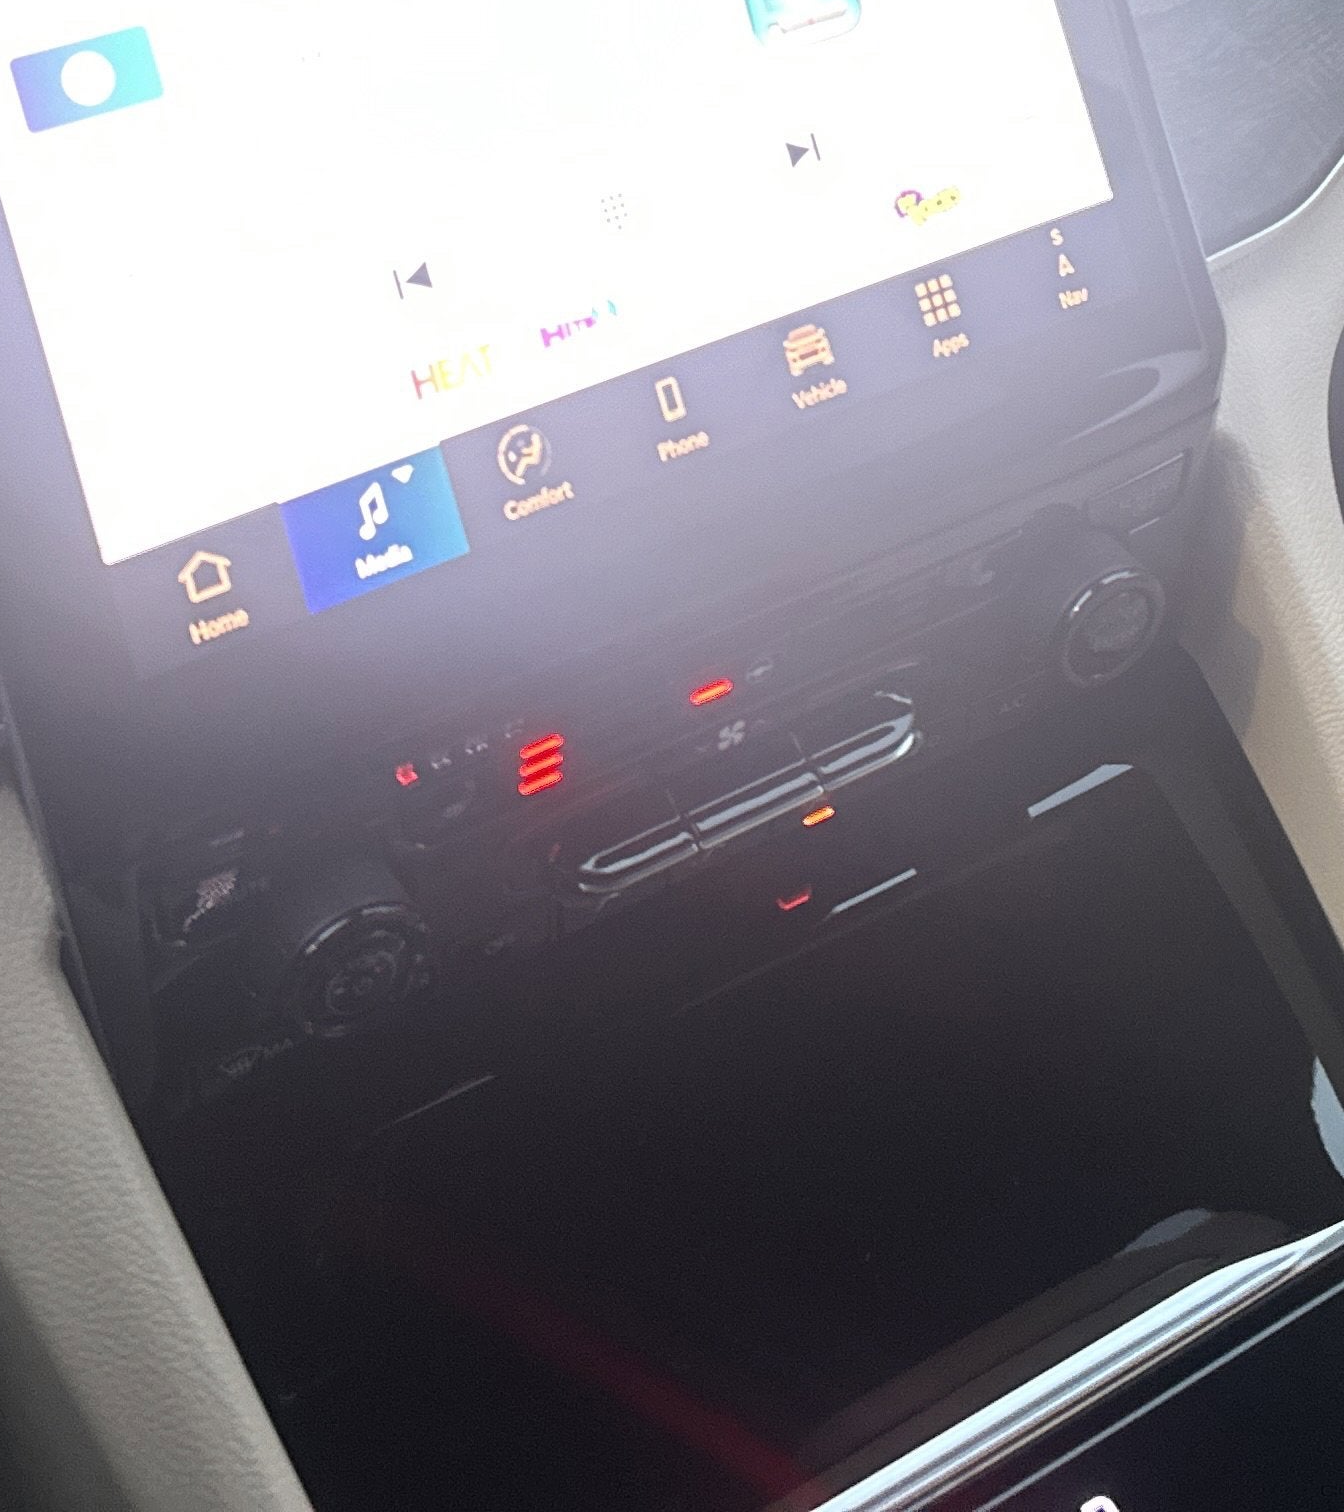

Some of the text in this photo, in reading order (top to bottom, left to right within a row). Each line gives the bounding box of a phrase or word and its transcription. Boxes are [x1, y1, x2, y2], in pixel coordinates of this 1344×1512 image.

[1058, 287, 1089, 310] Nav
[932, 332, 971, 359] Apps
[411, 343, 492, 400] HEAT
[791, 377, 849, 410] Vehicle
[656, 430, 710, 463] Phone
[503, 480, 576, 521] Comfort
[355, 543, 414, 580] Media
[188, 608, 250, 645] Home
